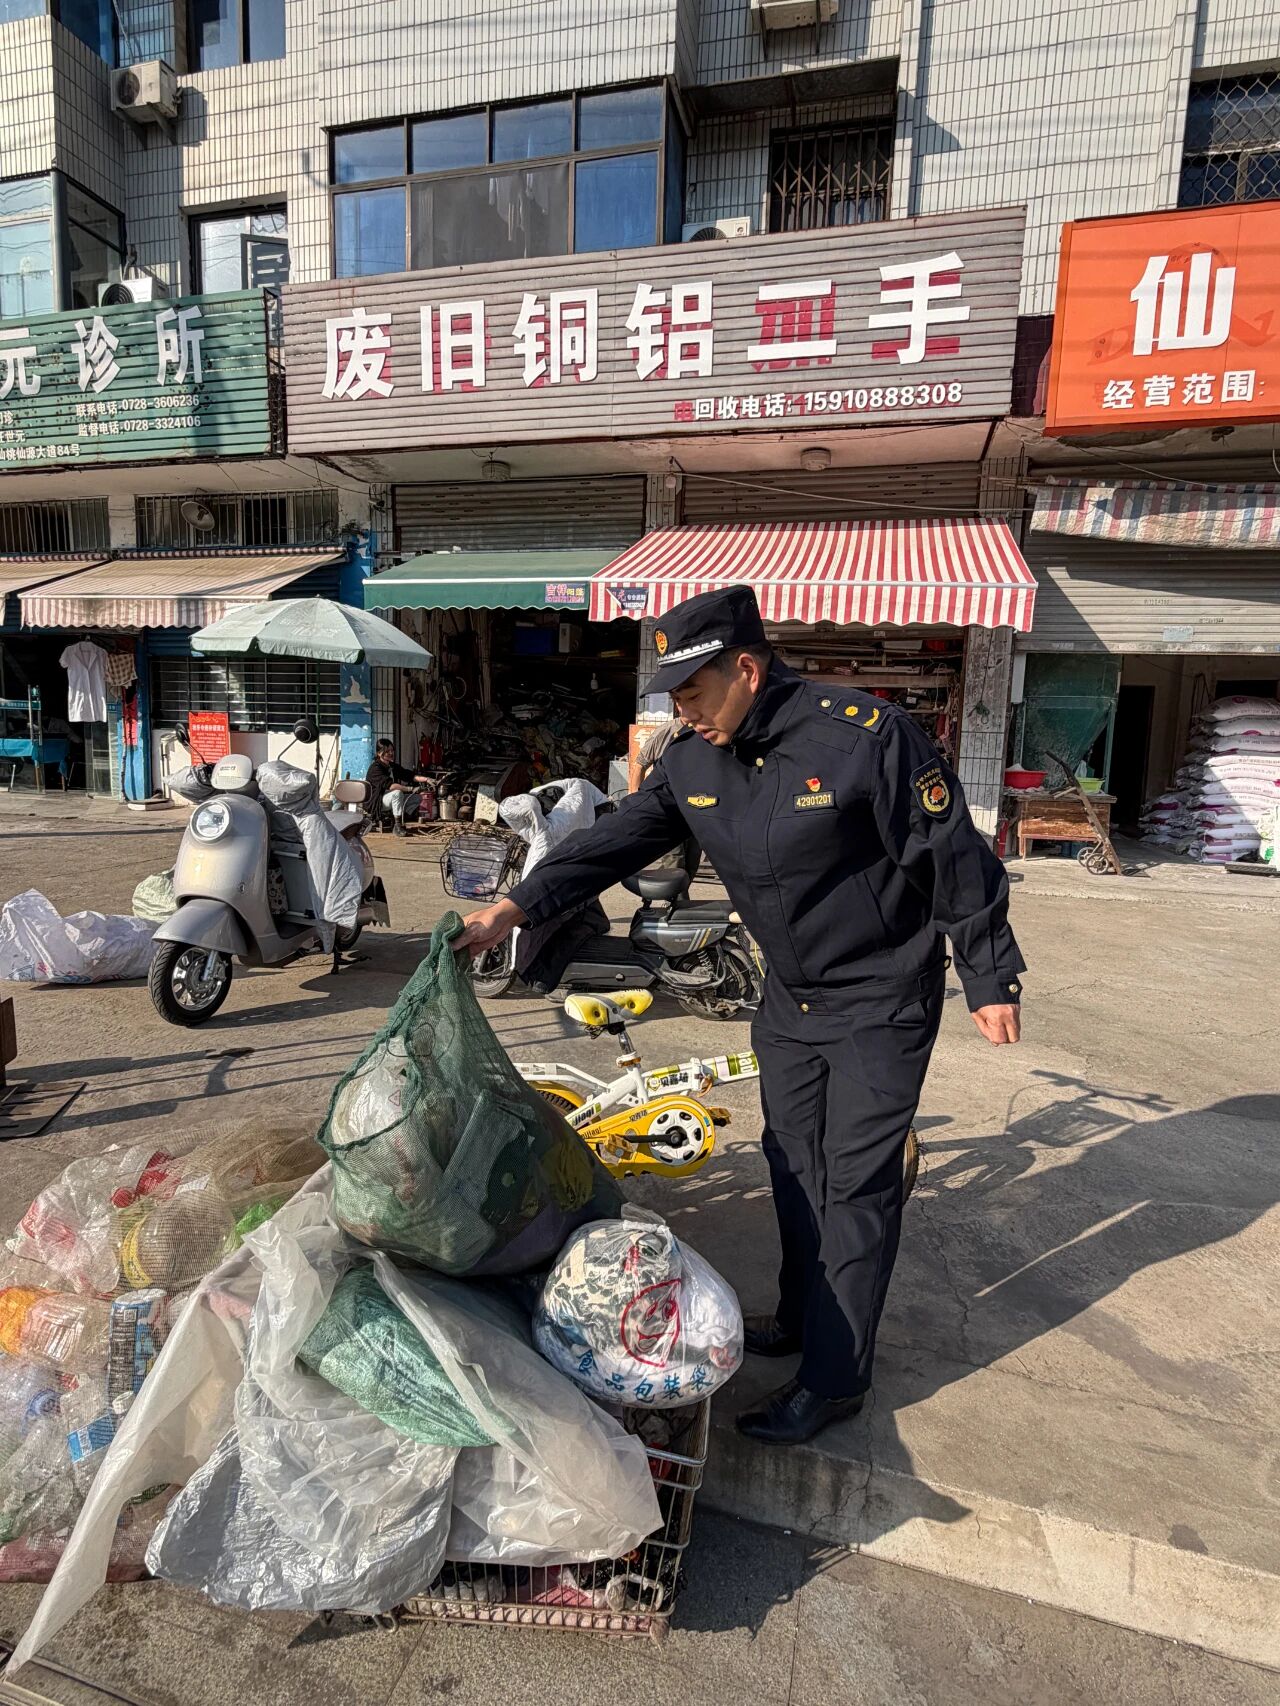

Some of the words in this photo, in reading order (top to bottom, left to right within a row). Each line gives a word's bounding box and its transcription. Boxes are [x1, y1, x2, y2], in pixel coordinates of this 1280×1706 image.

[321, 251, 971, 400] 废旧铜铝二手
[1130, 252, 1236, 356] 仙
[1102, 369, 1265, 409] 经营范围:
[796, 794, 831, 807] 42901201
[576, 1350, 714, 1405] 食品包装袋
